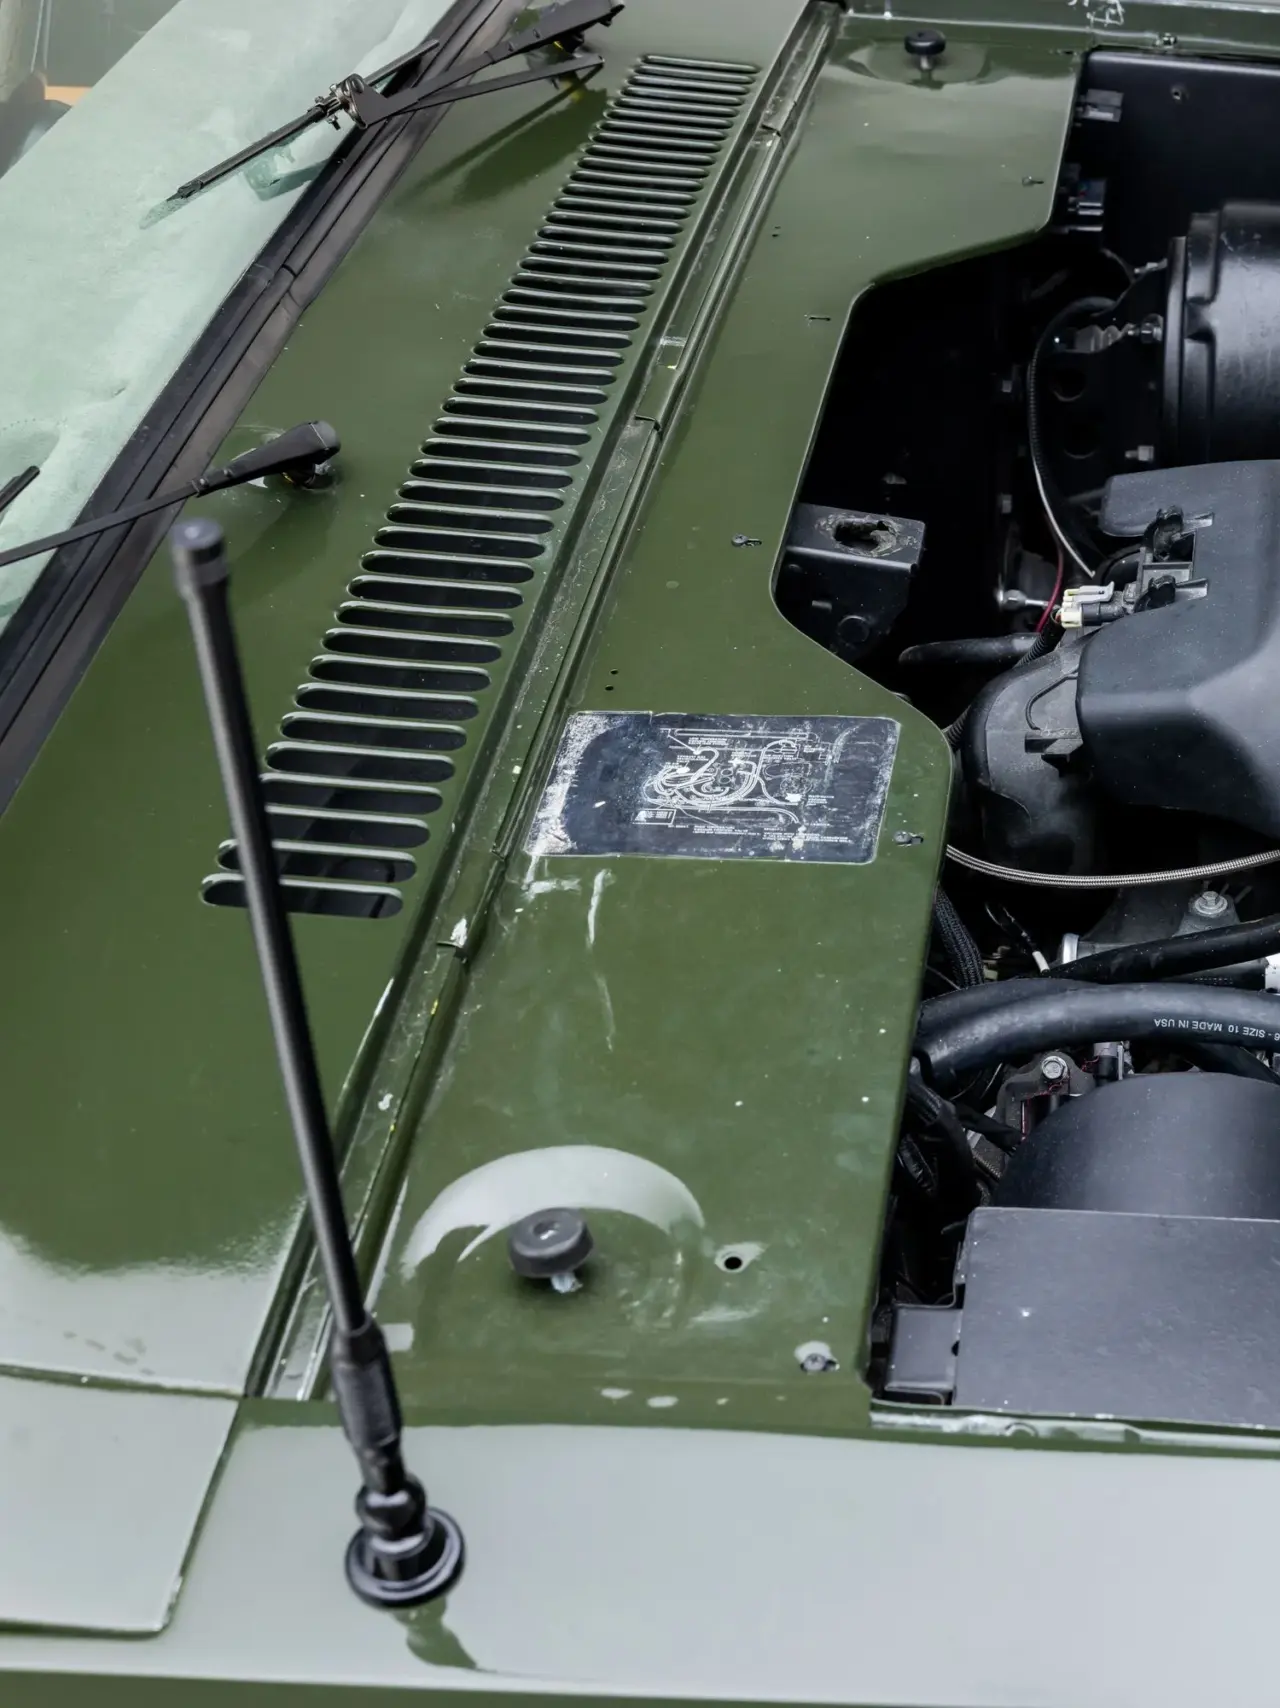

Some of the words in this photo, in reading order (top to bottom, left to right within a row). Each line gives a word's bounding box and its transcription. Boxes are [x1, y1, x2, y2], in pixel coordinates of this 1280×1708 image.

[1153, 1018, 1175, 1028] USA
[1178, 1019, 1189, 1029] IN
[1192, 1020, 1222, 1032] MADE
[1228, 1024, 1239, 1034] 10
[1242, 1026, 1266, 1038] SIZE
